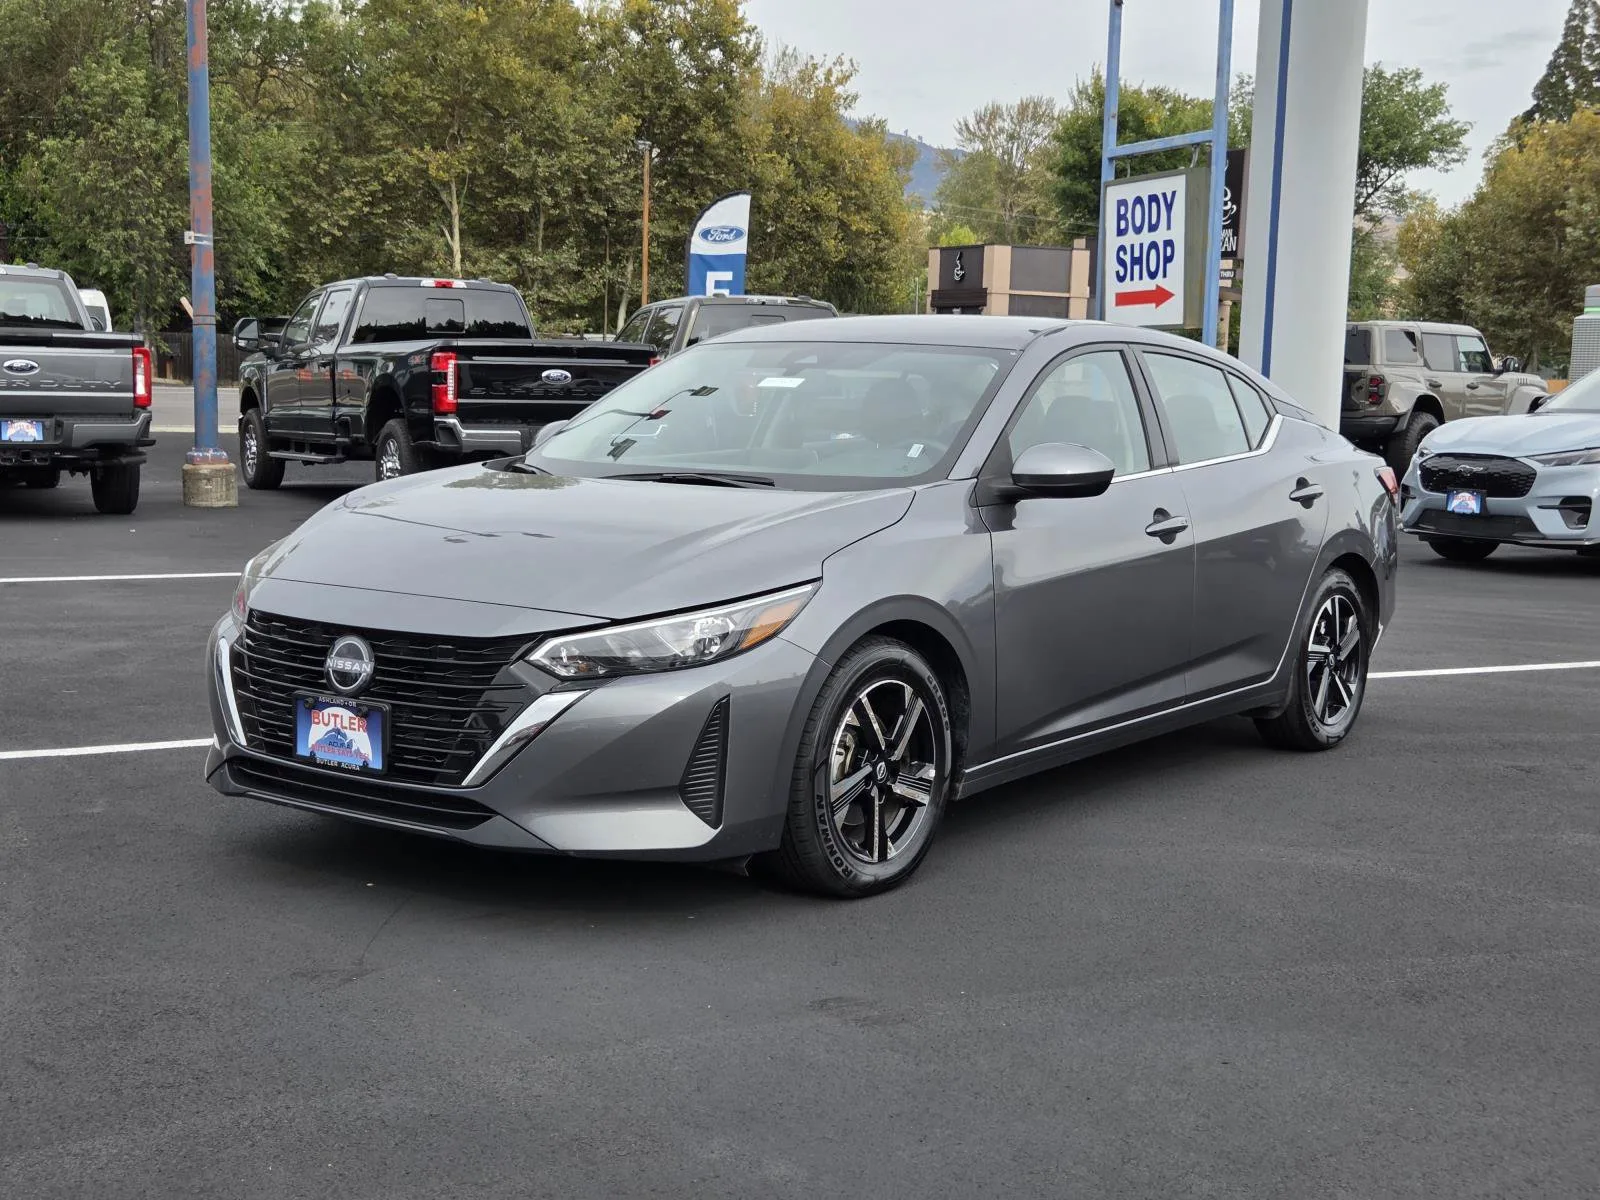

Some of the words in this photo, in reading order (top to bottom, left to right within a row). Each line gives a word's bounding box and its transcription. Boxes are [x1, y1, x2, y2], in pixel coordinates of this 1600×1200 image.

[1116, 190, 1177, 237] BODY
[707, 229, 736, 241] Ford
[1115, 239, 1175, 283] SHOP
[326, 657, 371, 672] NISSAN
[311, 710, 368, 733] BUTLER
[316, 758, 338, 767] BUTLER
[340, 762, 360, 771] ACURA
